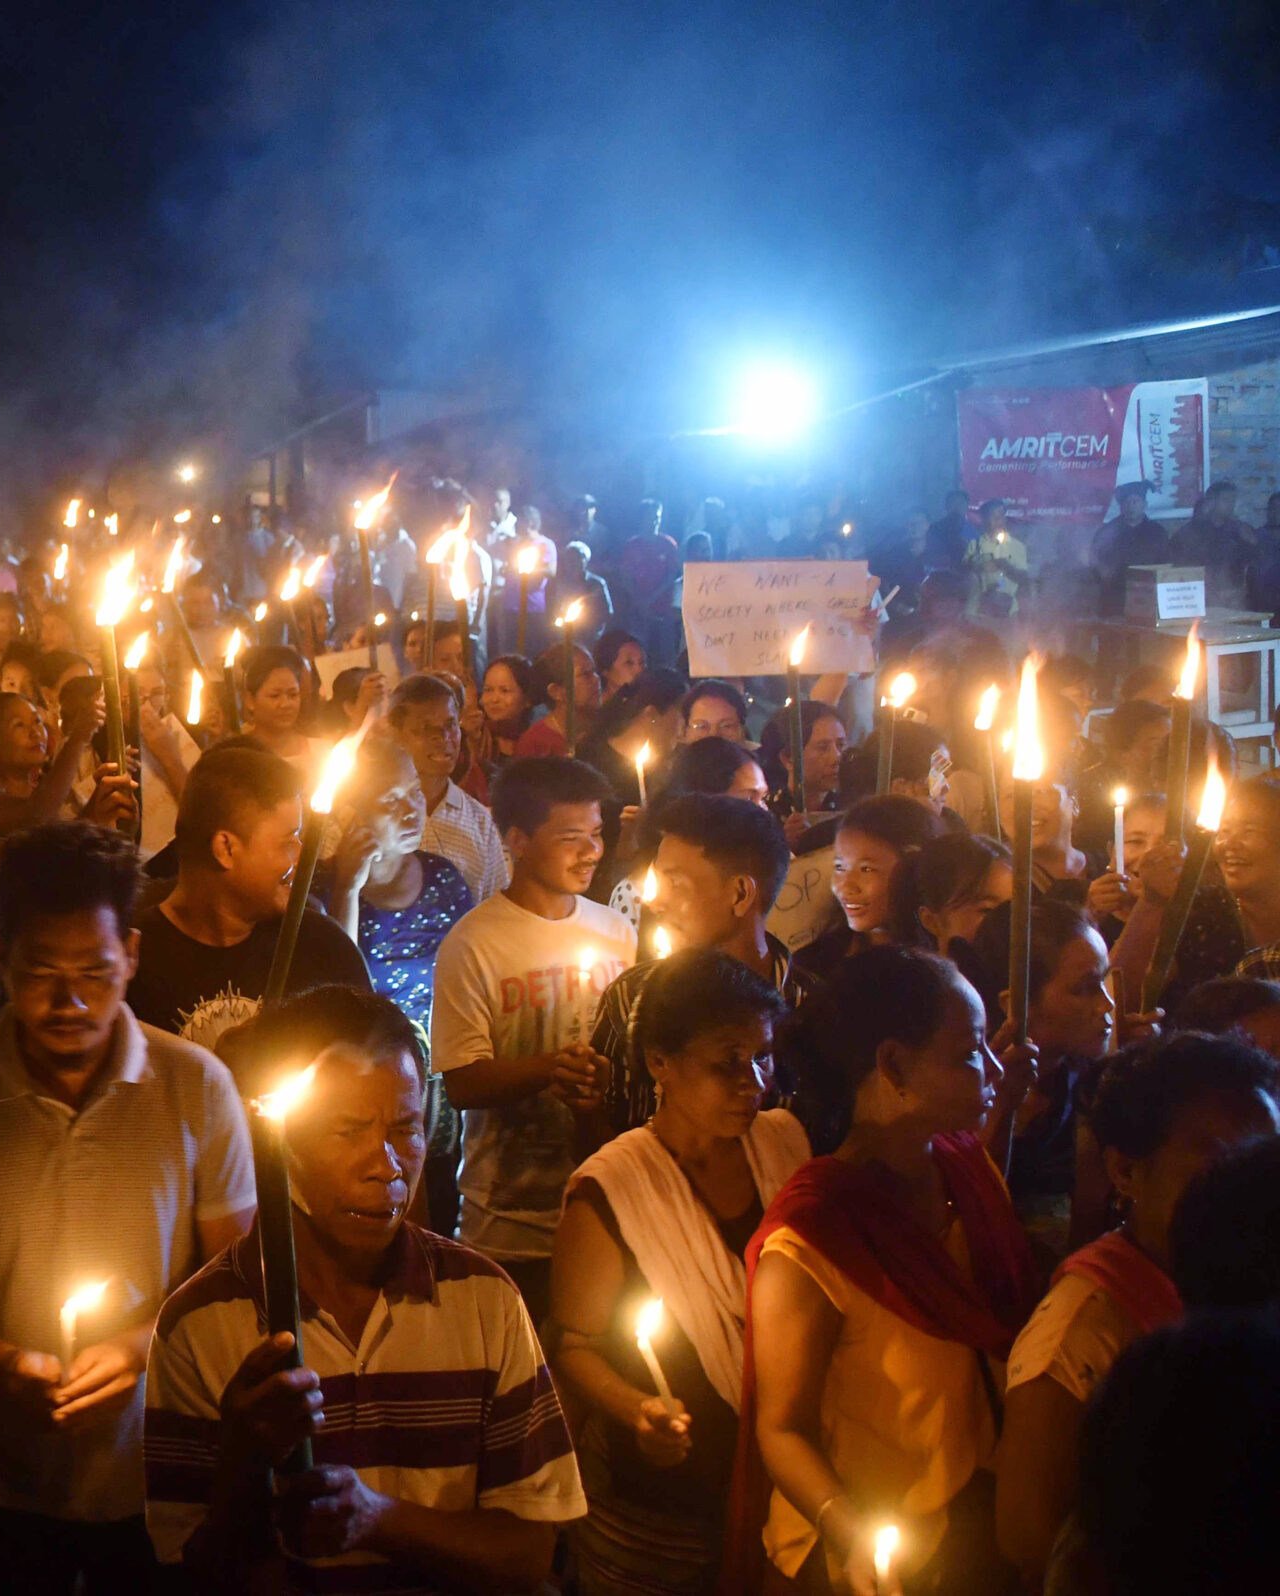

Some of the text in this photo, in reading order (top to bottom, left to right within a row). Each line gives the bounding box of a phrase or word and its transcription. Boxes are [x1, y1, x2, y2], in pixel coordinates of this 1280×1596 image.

[980, 432, 1109, 460] AMRITCEM
[978, 461, 1037, 474] Cementing
[754, 572, 800, 591] WANT
[696, 603, 753, 622] SOCIETY
[765, 599, 810, 616] WHERE
